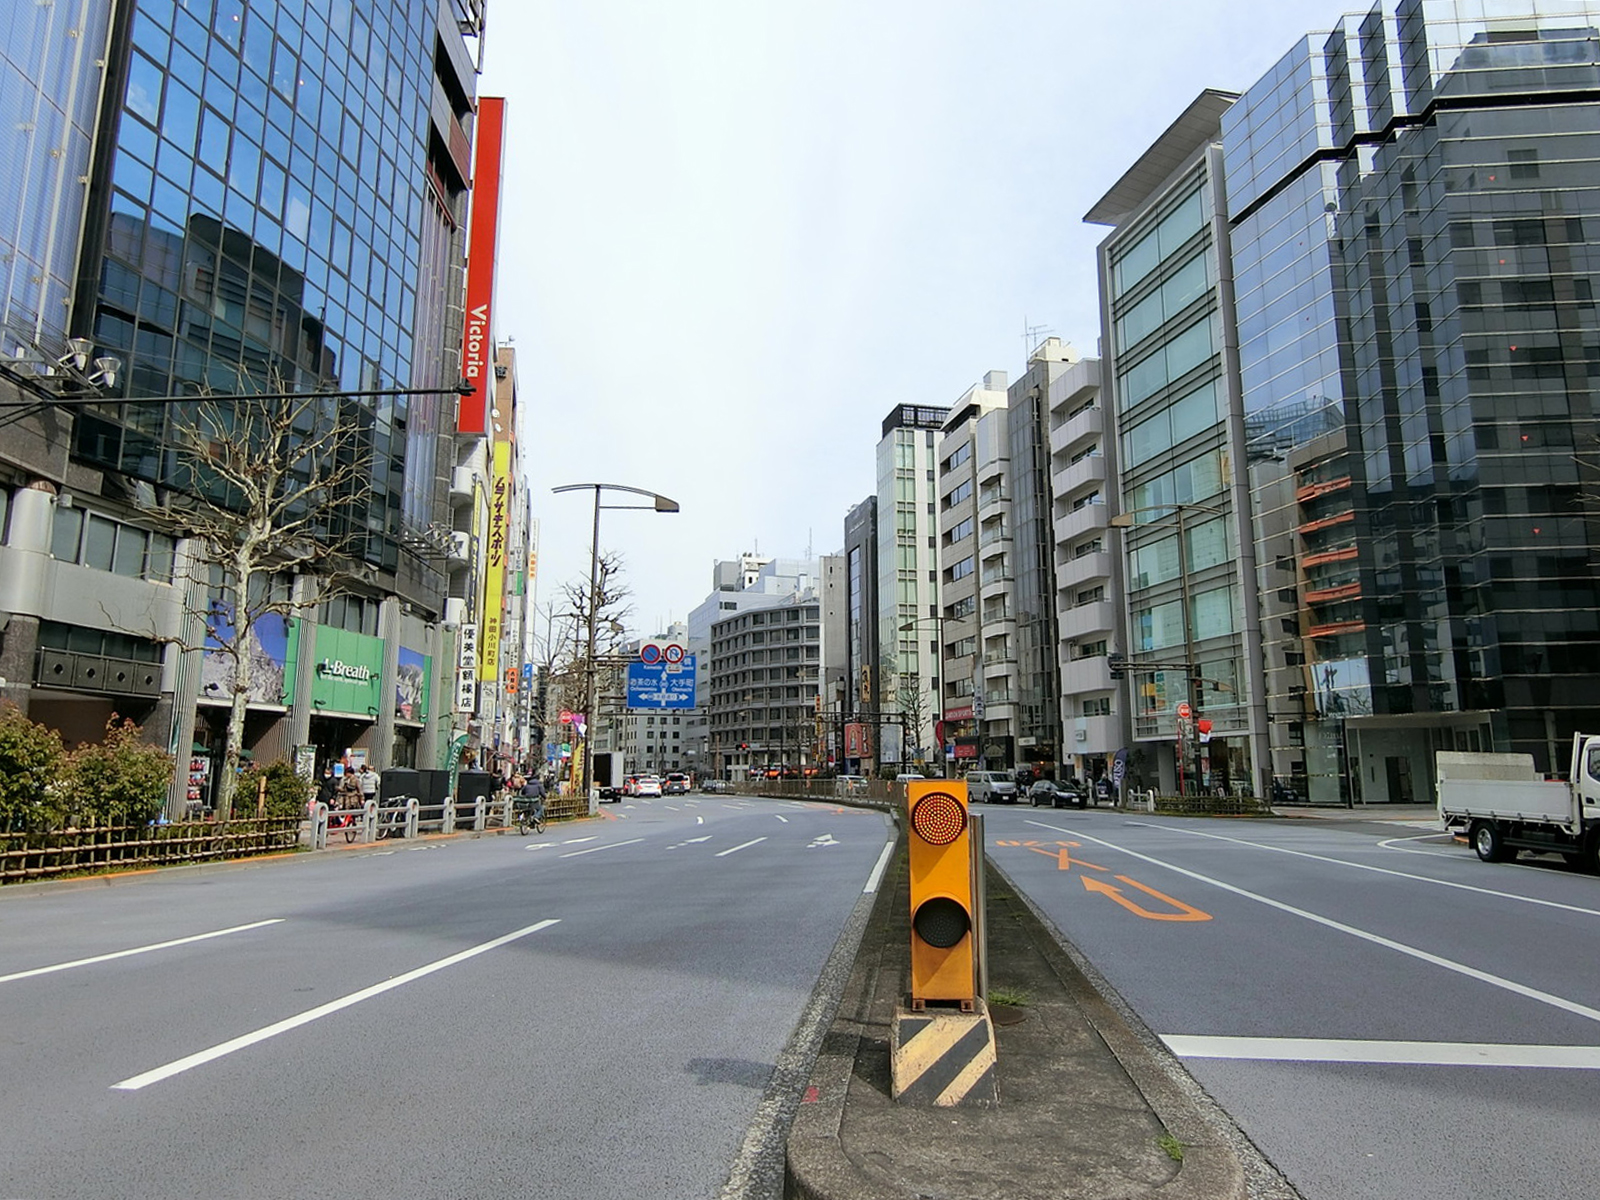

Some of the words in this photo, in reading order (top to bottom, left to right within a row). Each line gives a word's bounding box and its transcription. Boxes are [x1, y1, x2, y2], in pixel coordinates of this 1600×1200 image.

[467, 304, 488, 377] Victoria
[491, 477, 505, 567] ムラサキスポーツ
[462, 628, 475, 667] 優美堂
[487, 617, 497, 666] 神田小川町店
[630, 678, 658, 686] お茶の水
[670, 678, 694, 687] 大手町
